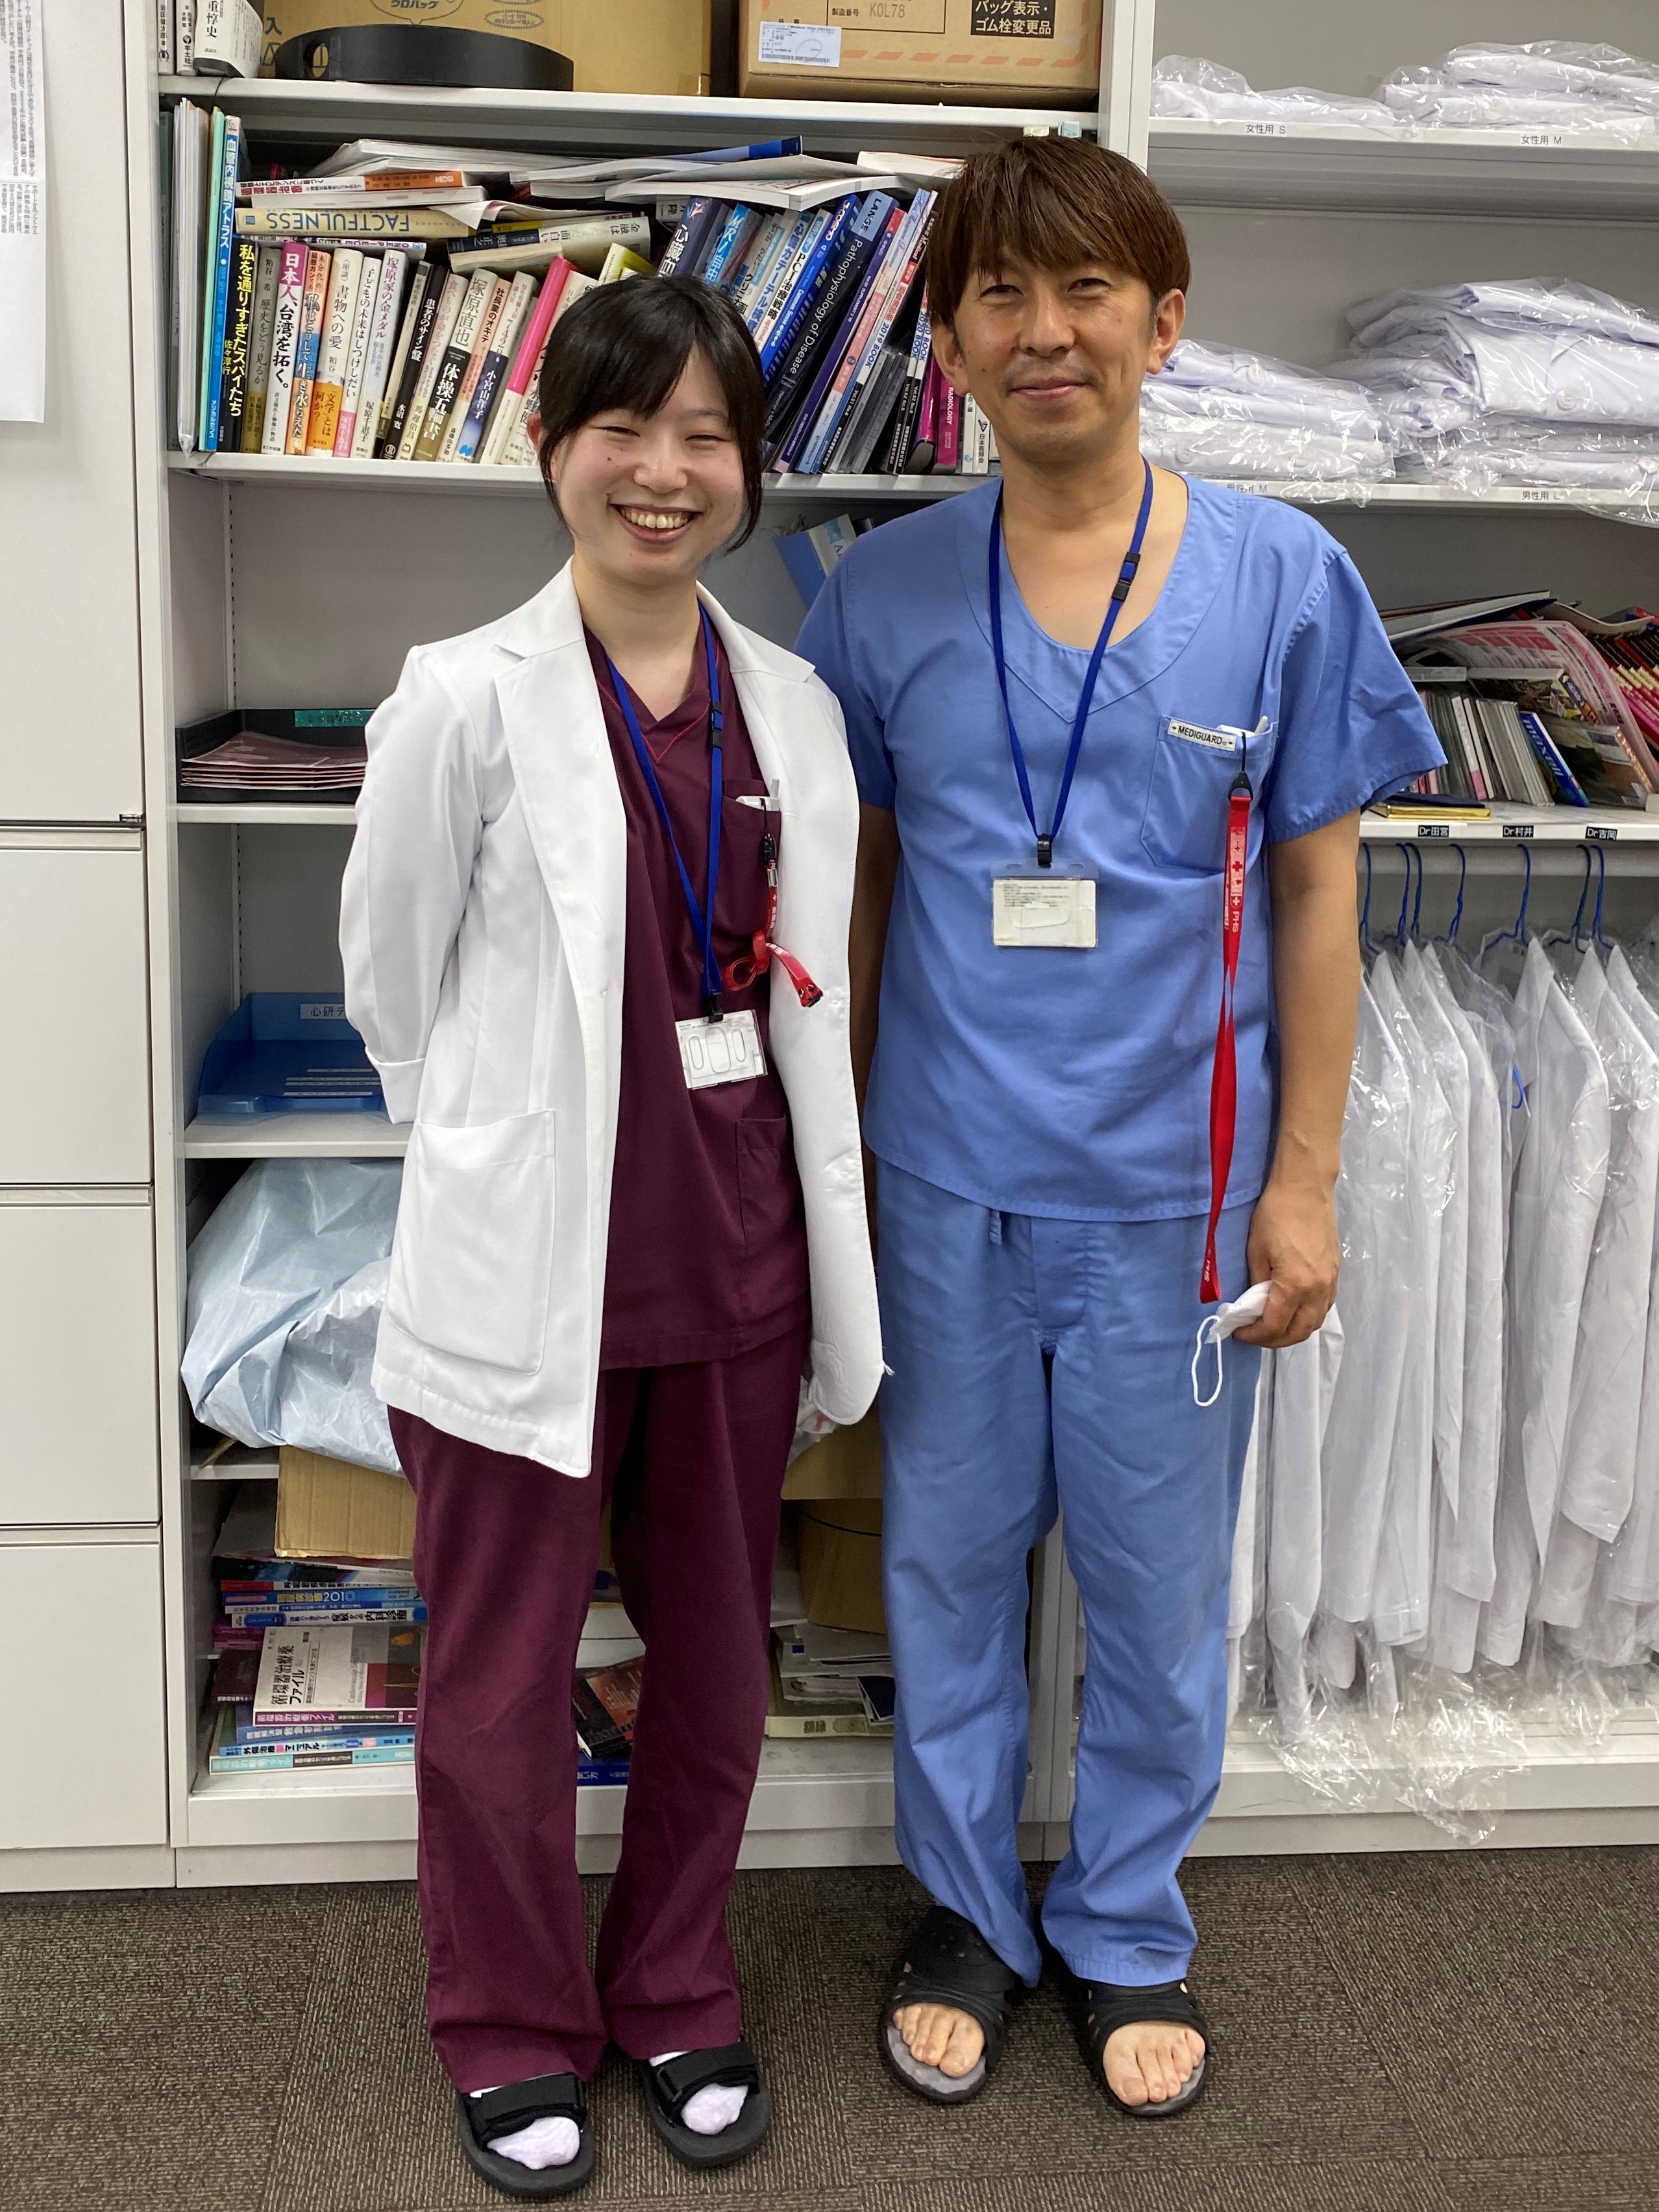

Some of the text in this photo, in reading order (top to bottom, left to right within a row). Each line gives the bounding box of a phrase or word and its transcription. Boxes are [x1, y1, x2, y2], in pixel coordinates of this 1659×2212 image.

[264, 17, 282, 35] 入
[975, 18, 1051, 36] ゴム栓変更品
[1246, 123, 1286, 135] 女性用 S
[1521, 134, 1562, 145] 女性用 M
[265, 212, 410, 232] FACTFULNESS
[862, 198, 882, 232] LANGE
[375, 256, 399, 339] 塚原家の金メダル
[817, 238, 863, 322] Pathophysiology
[272, 252, 301, 389] 日本人、台湾を拓く。
[328, 284, 350, 350] 書物への愛
[454, 276, 487, 347] 塚原直也
[481, 287, 505, 343] 社長業のオキテ
[809, 323, 820, 336] of
[228, 244, 255, 417] 私を通りすぎたスパイたち
[253, 299, 272, 385] 歴史をどう見るか
[346, 268, 375, 397] 子どもの未来はしつけしだい
[878, 322, 890, 344] 2019
[911, 334, 923, 360] BOOK
[222, 339, 233, 375] 佐々淳行
[293, 293, 320, 437] 私はこうして生き永らえた
[789, 335, 816, 375] Disease
[865, 344, 879, 369] BOOK
[918, 336, 931, 362] BOOK
[423, 362, 461, 441] 体操五輪書
[474, 370, 497, 420] 小宮山洋子
[946, 386, 955, 426] RADIOLOGY
[361, 400, 375, 442] 塚原千恵子
[1259, 485, 1267, 493] M
[1521, 491, 1549, 500] 男性用
[1177, 725, 1223, 745] MEDIGUARD
[1522, 719, 1564, 778] maxell
[1503, 826, 1534, 837] Dr村井
[1587, 828, 1617, 841] Dr吉岡
[1232, 911, 1240, 933] PHS
[289, 1669, 305, 1705] ファイル
